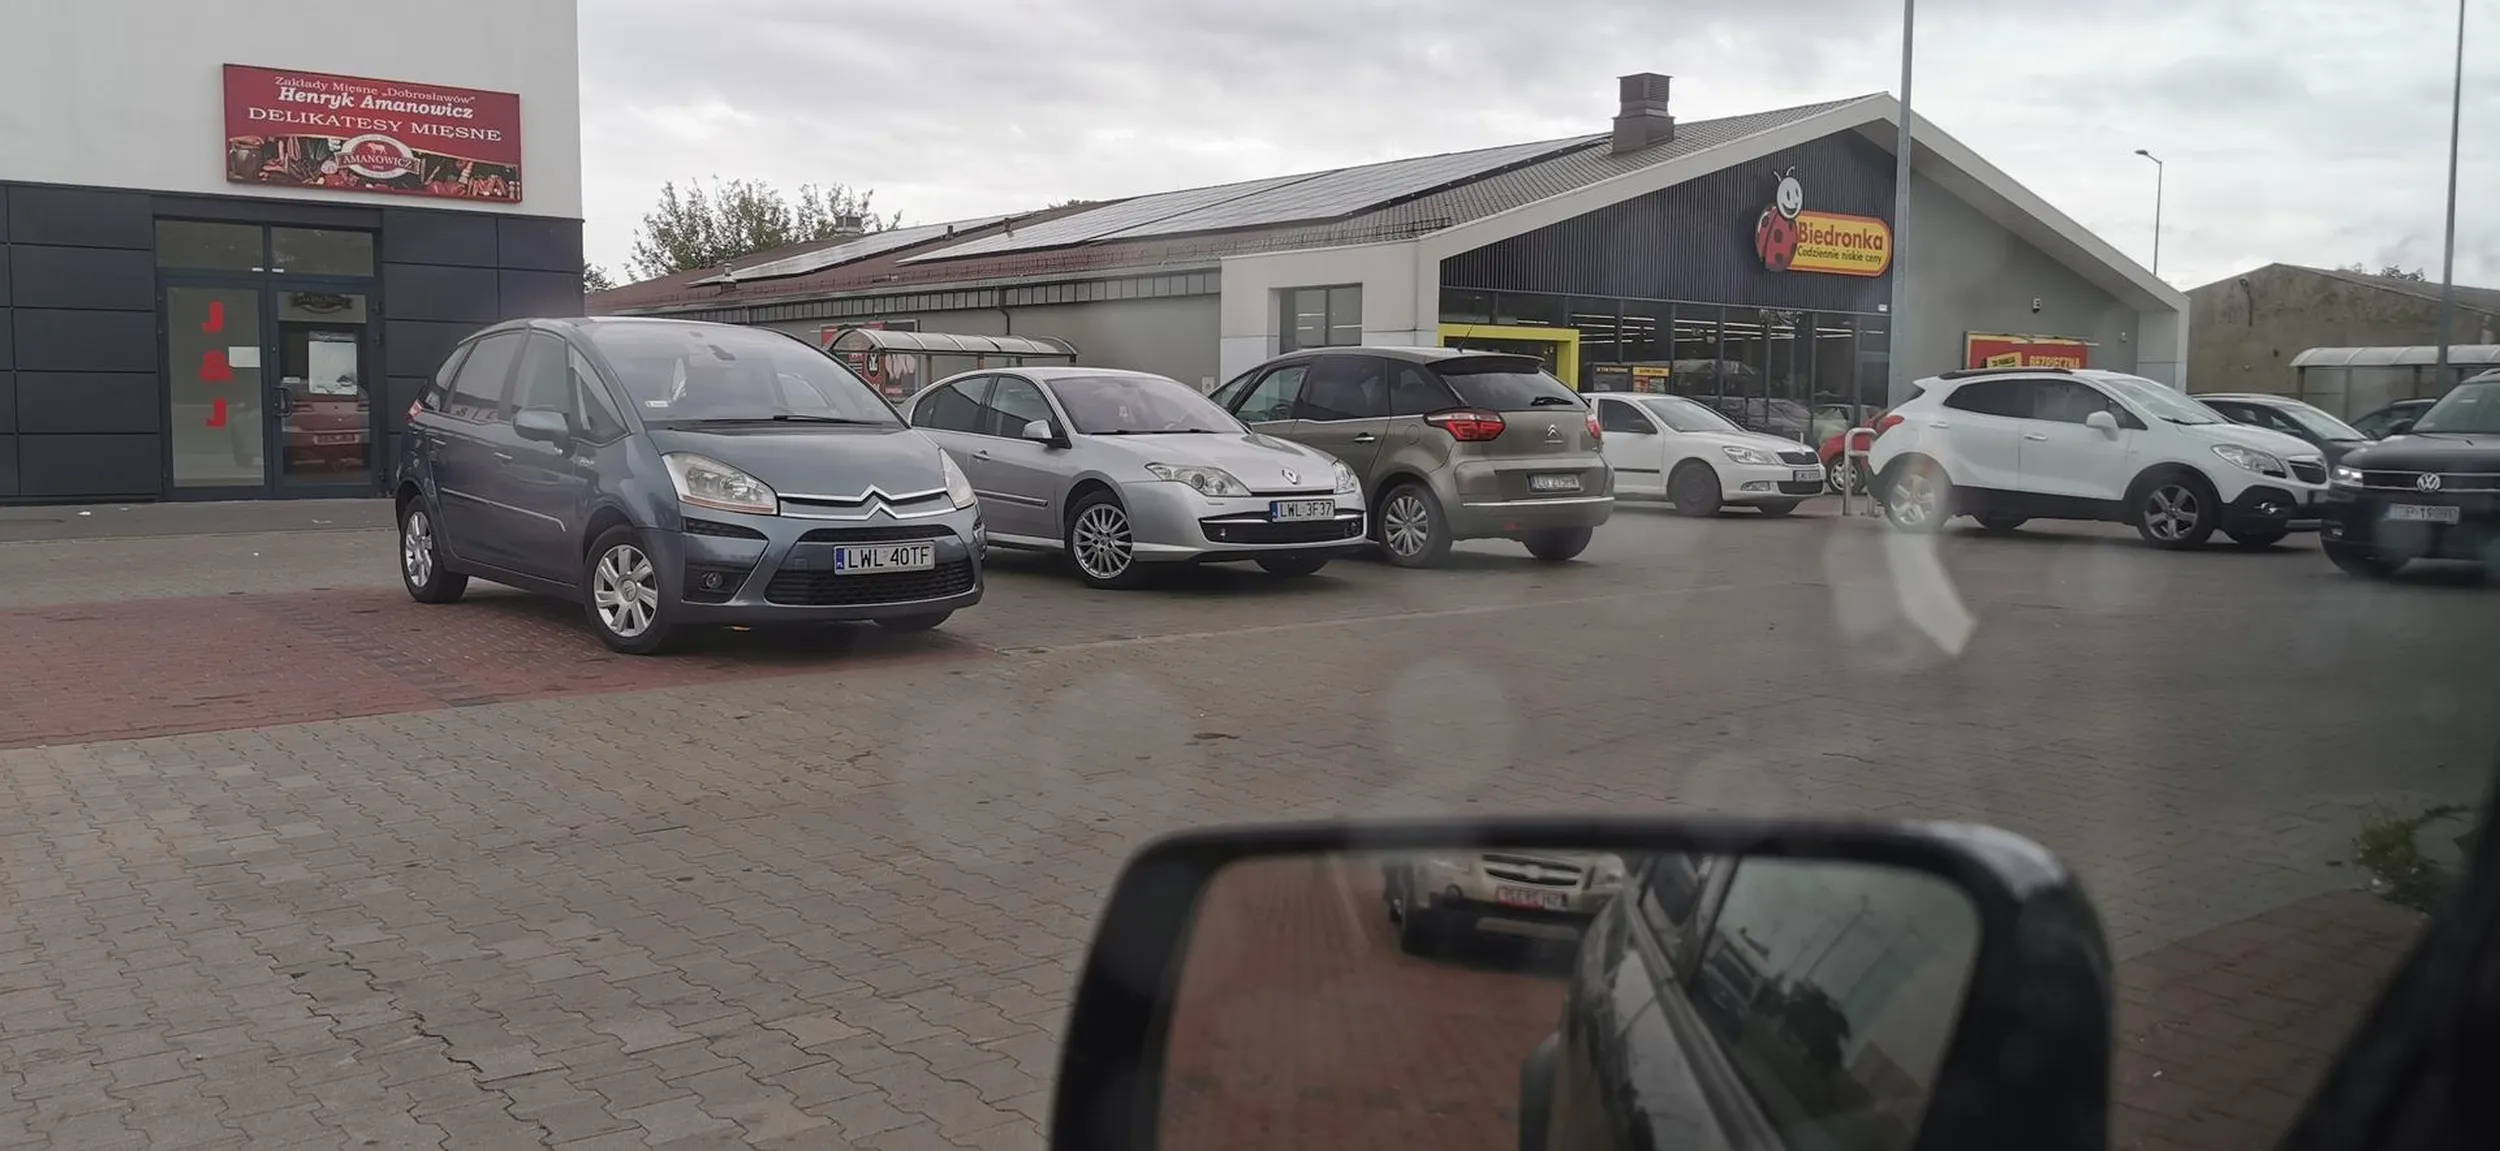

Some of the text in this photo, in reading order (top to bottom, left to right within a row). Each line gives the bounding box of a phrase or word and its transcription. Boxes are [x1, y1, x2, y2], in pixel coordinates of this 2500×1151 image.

[275, 76, 328, 91] Zakłady
[333, 82, 378, 95] Mięsne
[278, 86, 474, 119] Henryk Amanowicz
[248, 106, 502, 142] DELIKATESY MIĘSNE
[343, 154, 412, 169] AMANOWICZ
[1798, 222, 1883, 251] Biedronka
[1797, 246, 1882, 264] Codziennie niskie ceny
[1280, 503, 1302, 517] LWL
[848, 546, 930, 568] LWL 40TF
